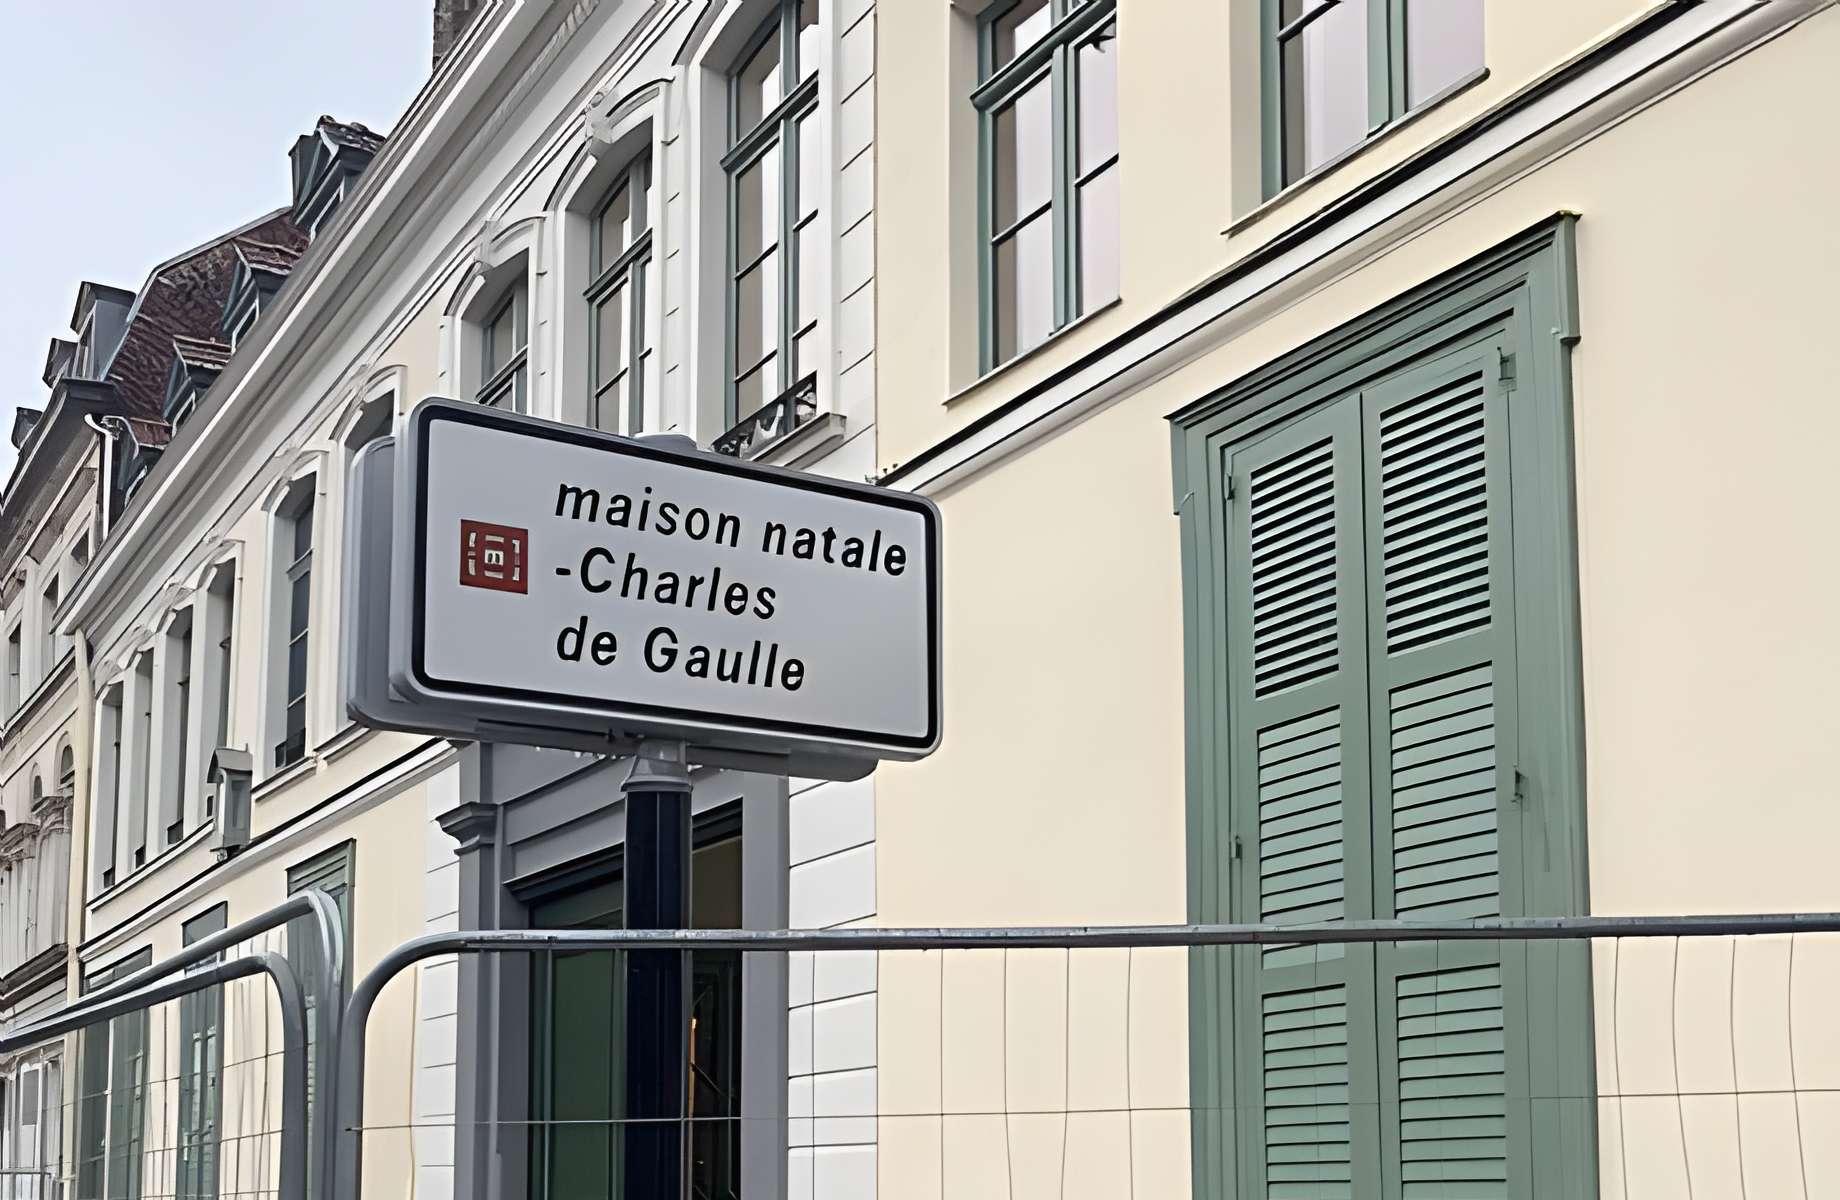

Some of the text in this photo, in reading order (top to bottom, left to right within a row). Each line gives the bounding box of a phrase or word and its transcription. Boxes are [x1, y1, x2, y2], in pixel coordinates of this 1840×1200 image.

[554, 483, 908, 577] maison natale
[556, 615, 806, 692] de Gaulle
